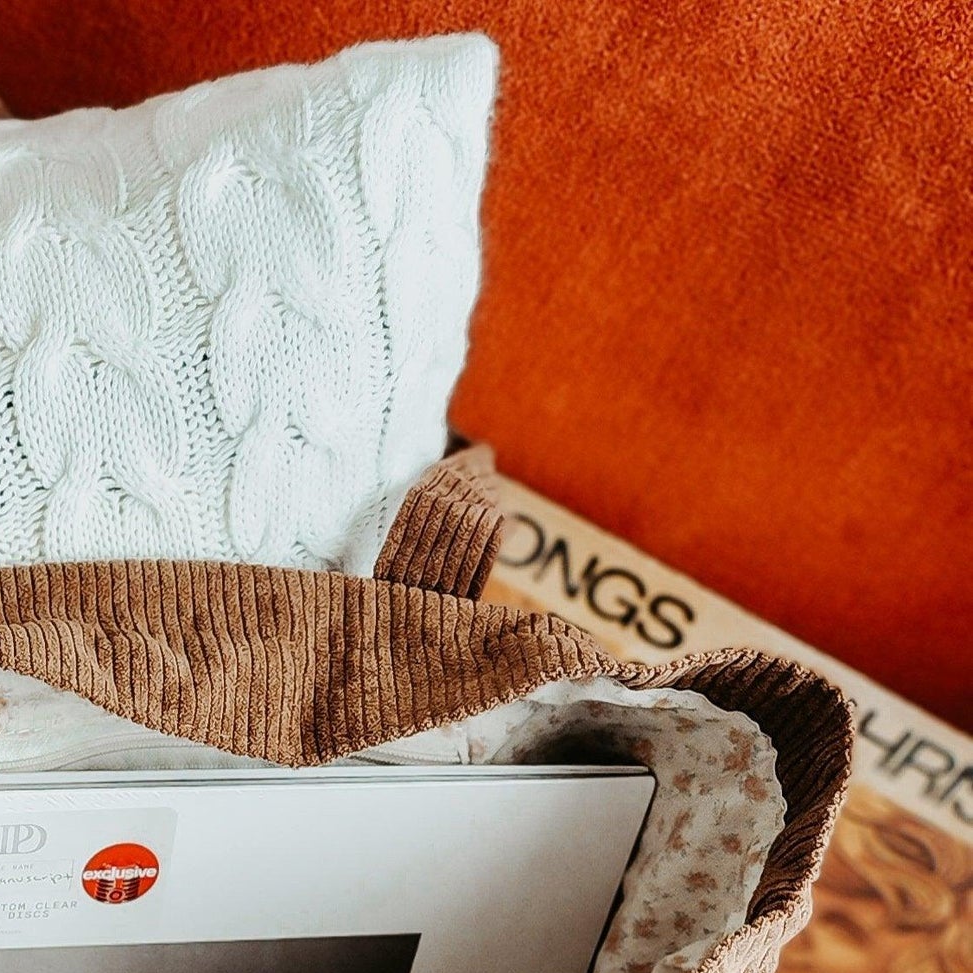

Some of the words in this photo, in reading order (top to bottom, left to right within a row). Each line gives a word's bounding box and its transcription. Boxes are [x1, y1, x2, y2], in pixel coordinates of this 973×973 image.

[497, 513, 695, 650] ONGS
[82, 865, 158, 881] exclusive
[35, 900, 78, 911] CLEAR
[8, 909, 50, 920] DISCS
